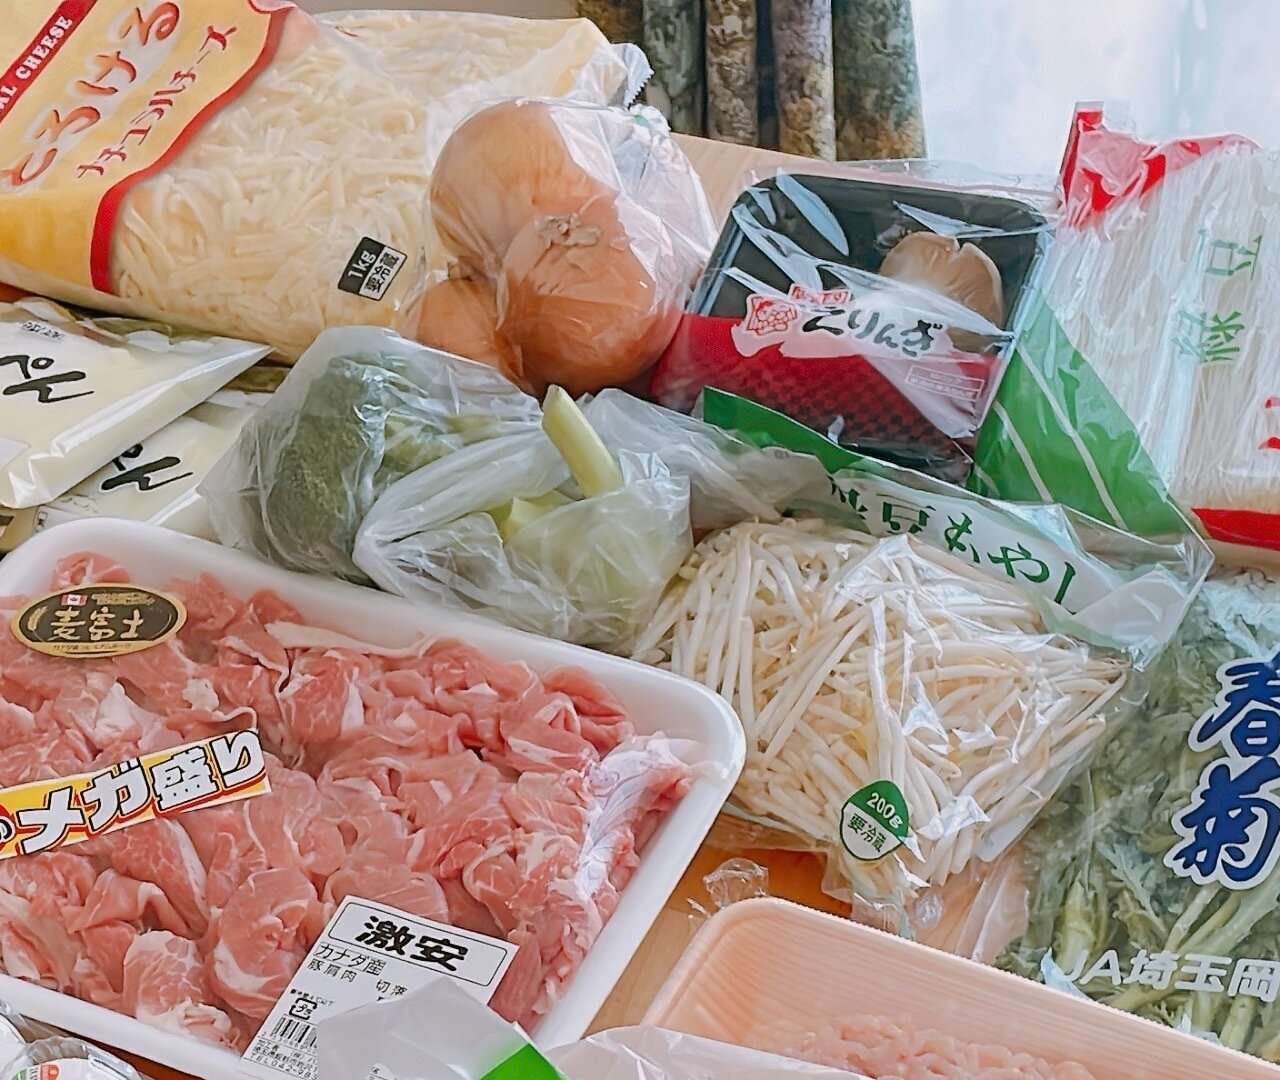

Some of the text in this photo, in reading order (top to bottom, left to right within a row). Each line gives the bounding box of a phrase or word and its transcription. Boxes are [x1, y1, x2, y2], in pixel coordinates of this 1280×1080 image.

[15, 16, 73, 81] CHEESE
[348, 250, 378, 278] 1kg
[47, 606, 145, 641] 麦富士
[18, 732, 267, 854] メガ盛り
[864, 791, 904, 830] 200g
[847, 812, 887, 854] 要冷蔵
[314, 944, 388, 977] カナダ産
[355, 915, 469, 973] 激安
